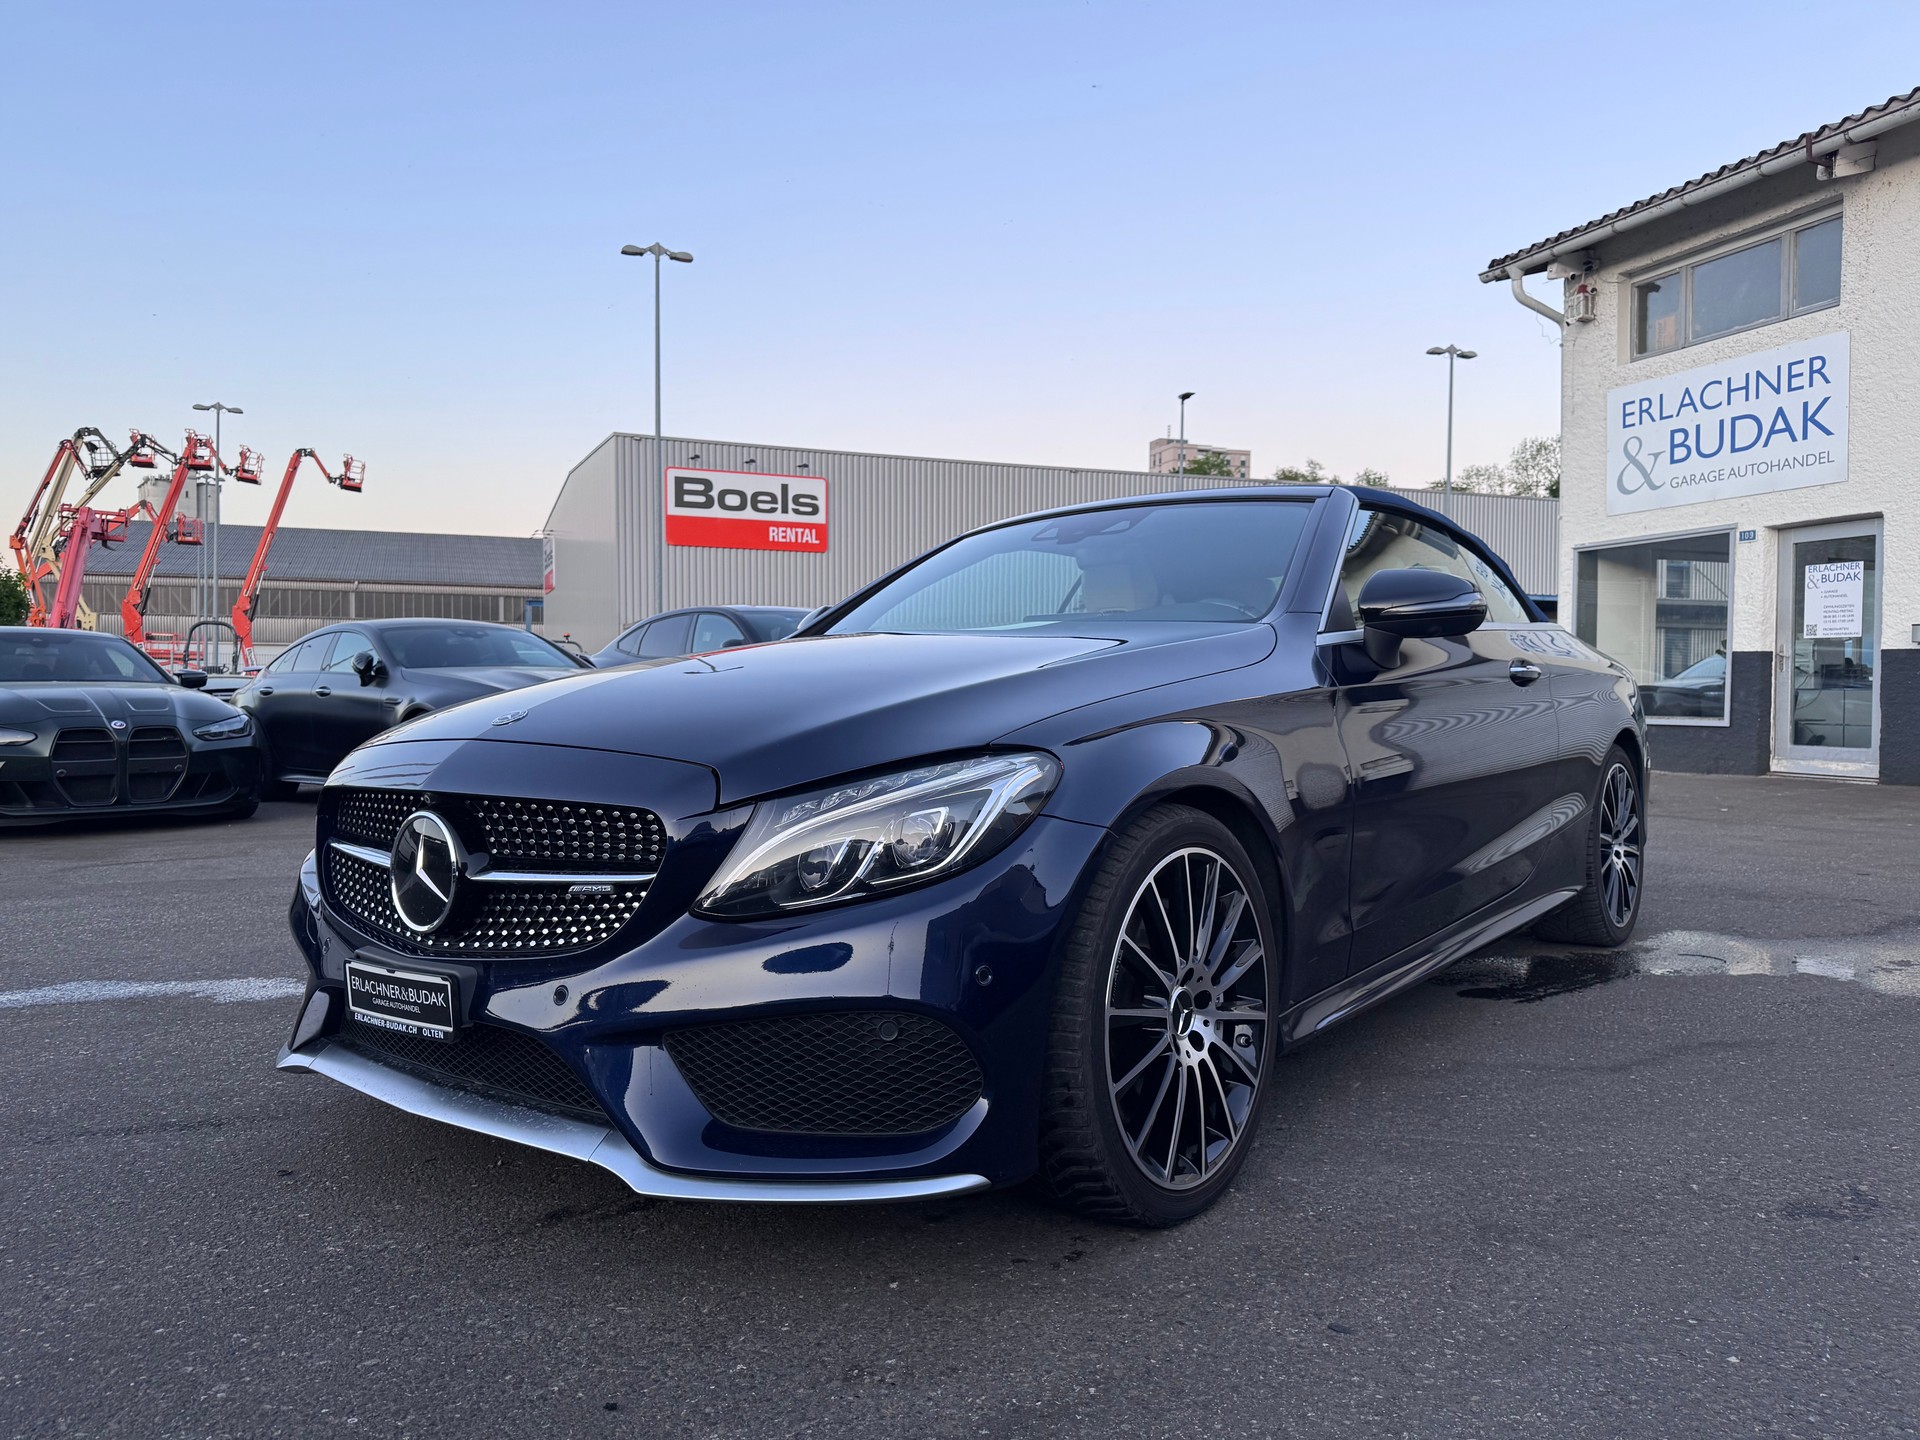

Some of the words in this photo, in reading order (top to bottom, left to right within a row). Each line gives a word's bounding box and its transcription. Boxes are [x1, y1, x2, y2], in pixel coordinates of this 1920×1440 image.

[1622, 355, 1831, 429] ERLACHNER
[1616, 436, 1666, 495] &
[1669, 396, 1834, 465] BUDAK
[1670, 469, 1725, 489] GARAGE
[1727, 450, 1835, 480] AUTOHANDEL
[674, 475, 820, 516] Boels
[769, 526, 820, 544] RENTAL
[1741, 531, 1754, 540] 109
[1807, 574, 1820, 589] &
[1821, 571, 1861, 583] BUDAK
[1808, 562, 1861, 573] ERLACHNER
[354, 1012, 417, 1034] ERLACHNER-BUDAK.CH
[422, 1028, 444, 1039] OLTEN
